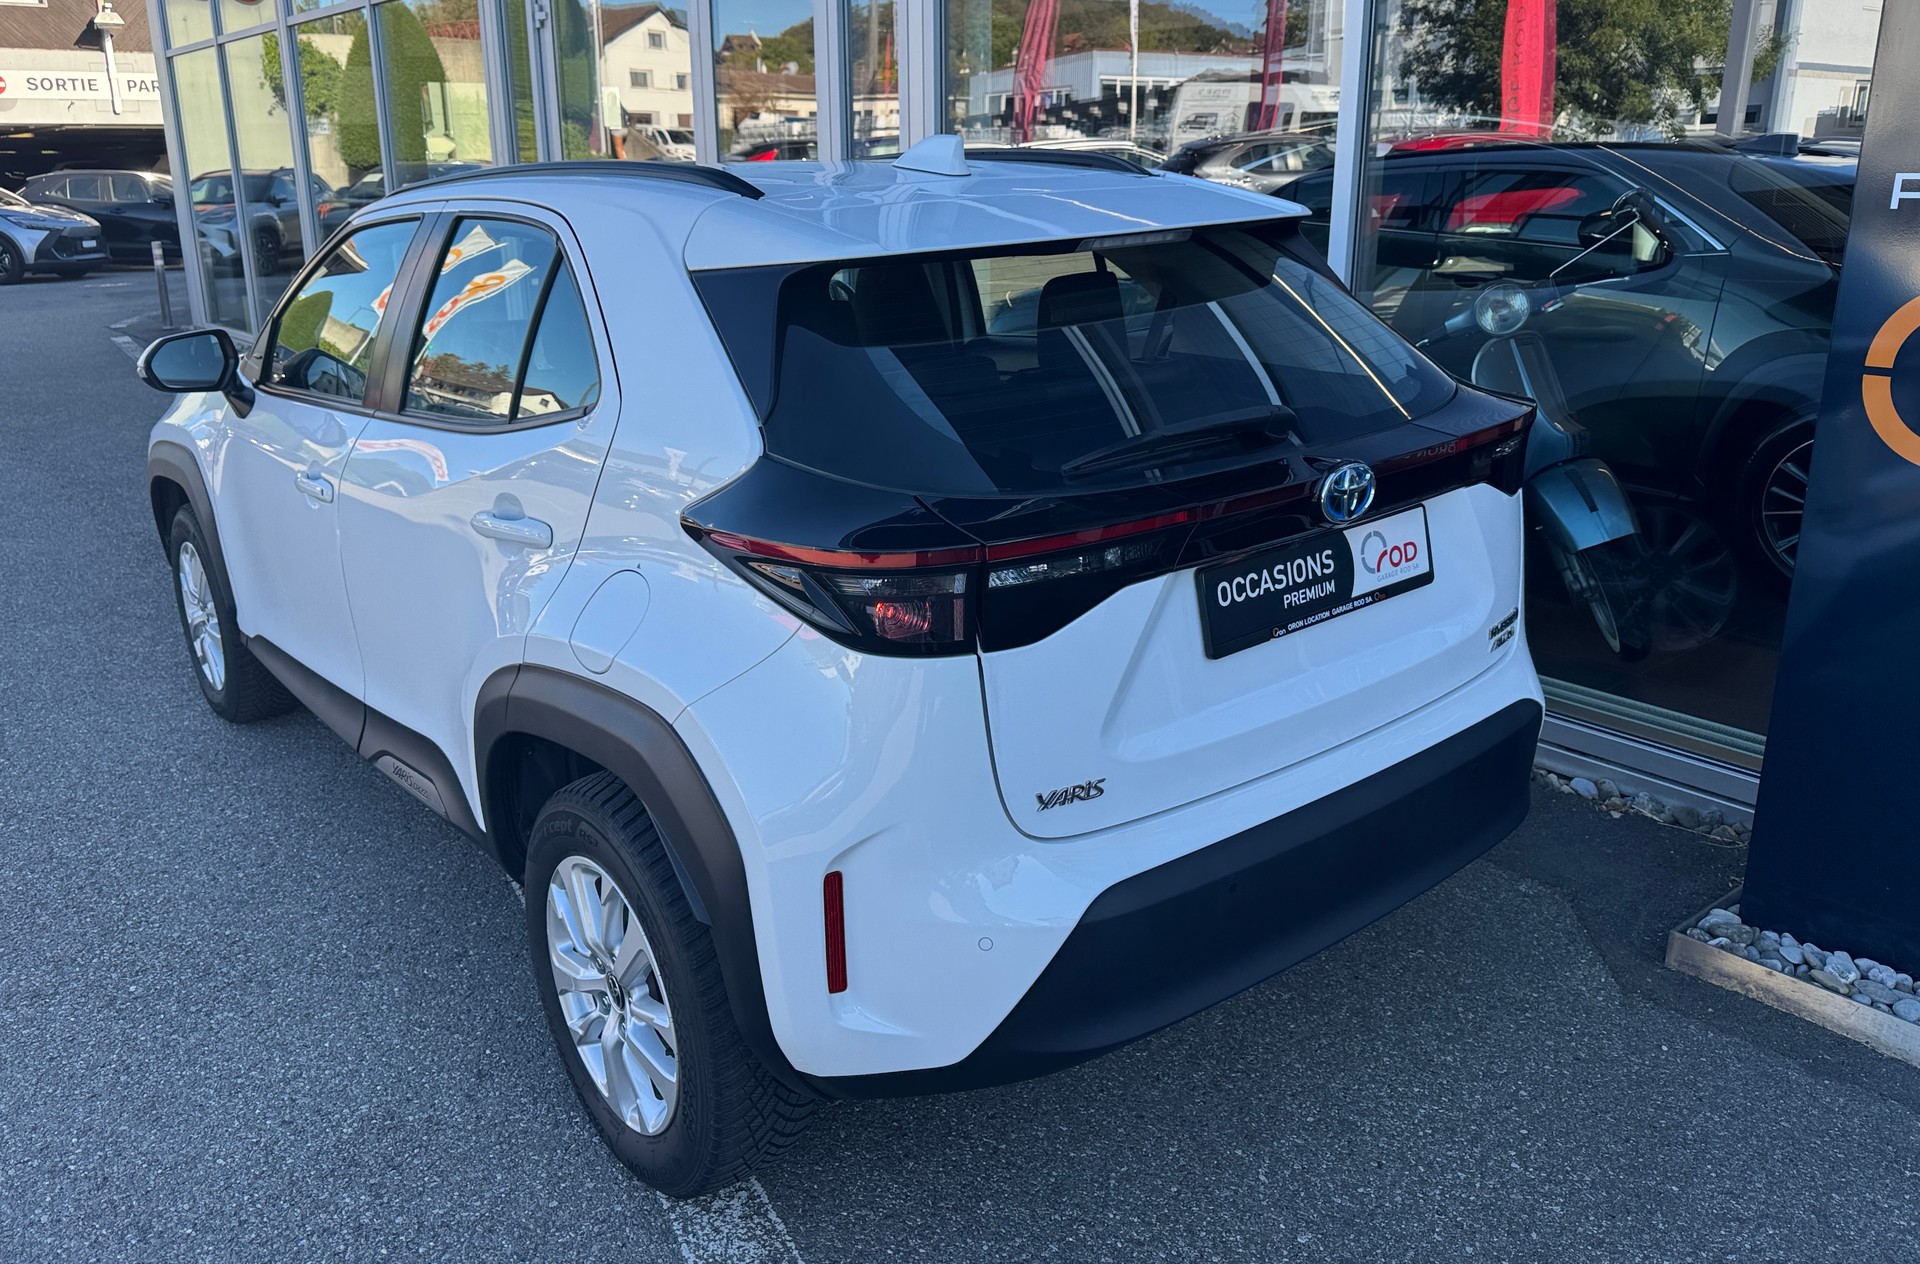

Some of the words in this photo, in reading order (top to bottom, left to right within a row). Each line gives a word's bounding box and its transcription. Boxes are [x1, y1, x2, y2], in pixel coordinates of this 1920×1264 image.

[26, 77, 99, 92] SORTIE
[1217, 549, 1335, 607] OCCASIONS
[1376, 569, 1399, 582] GARAGE
[1283, 579, 1336, 609] PREMIUM
[1287, 620, 1304, 631] ORON
[1304, 610, 1330, 626] LOCATION
[1331, 602, 1353, 615] GARAGE
[1365, 596, 1373, 604] SA
[392, 762, 415, 787] YARIS
[1035, 778, 1107, 812] YARIS
